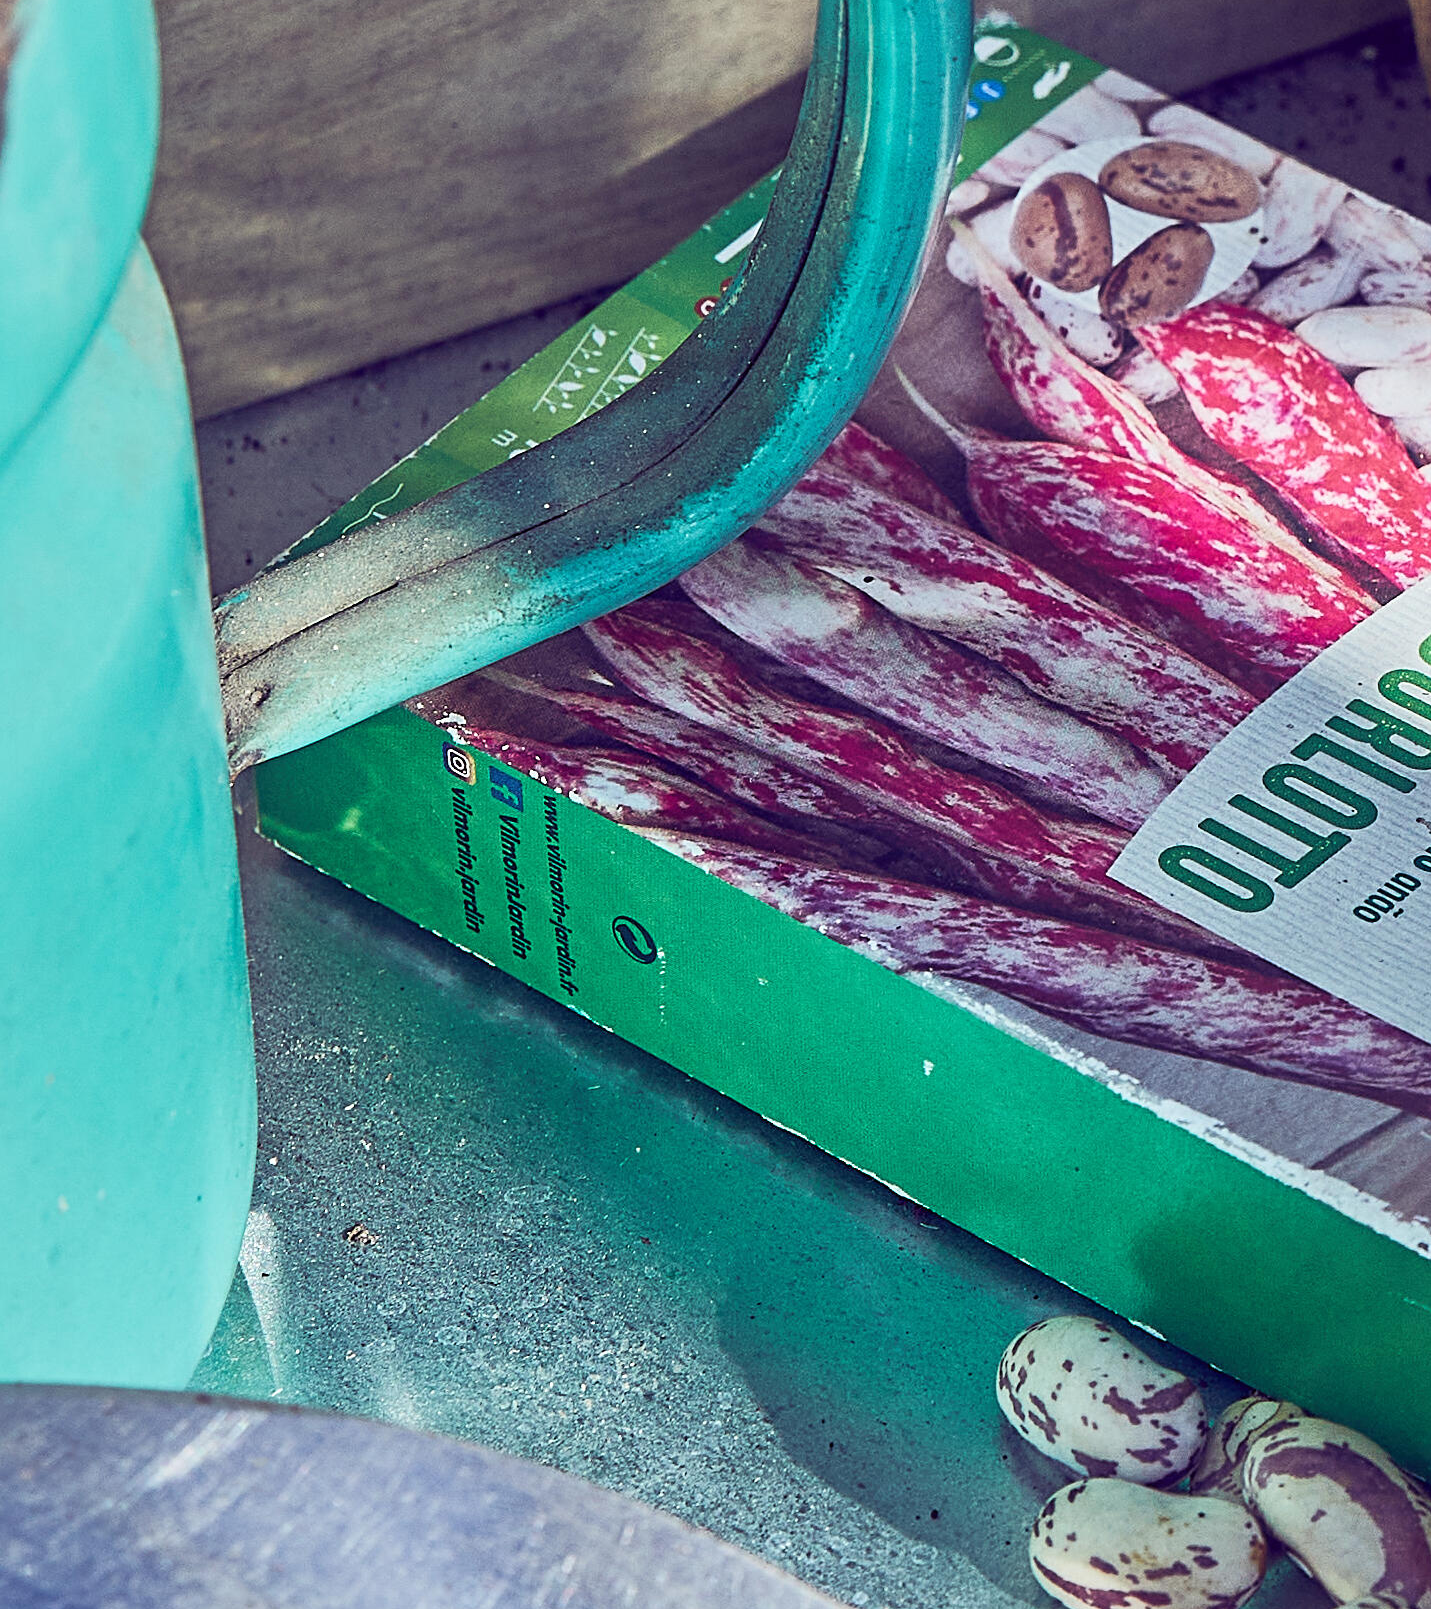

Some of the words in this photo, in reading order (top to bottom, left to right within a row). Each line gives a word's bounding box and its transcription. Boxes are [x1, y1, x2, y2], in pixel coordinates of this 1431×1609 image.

[451, 786, 485, 934] vilmorin.jardin
[499, 814, 532, 960] VilmorinJardin
[544, 795, 579, 996] www.vilmorin-jardin.fr
[1352, 871, 1422, 924] anão
